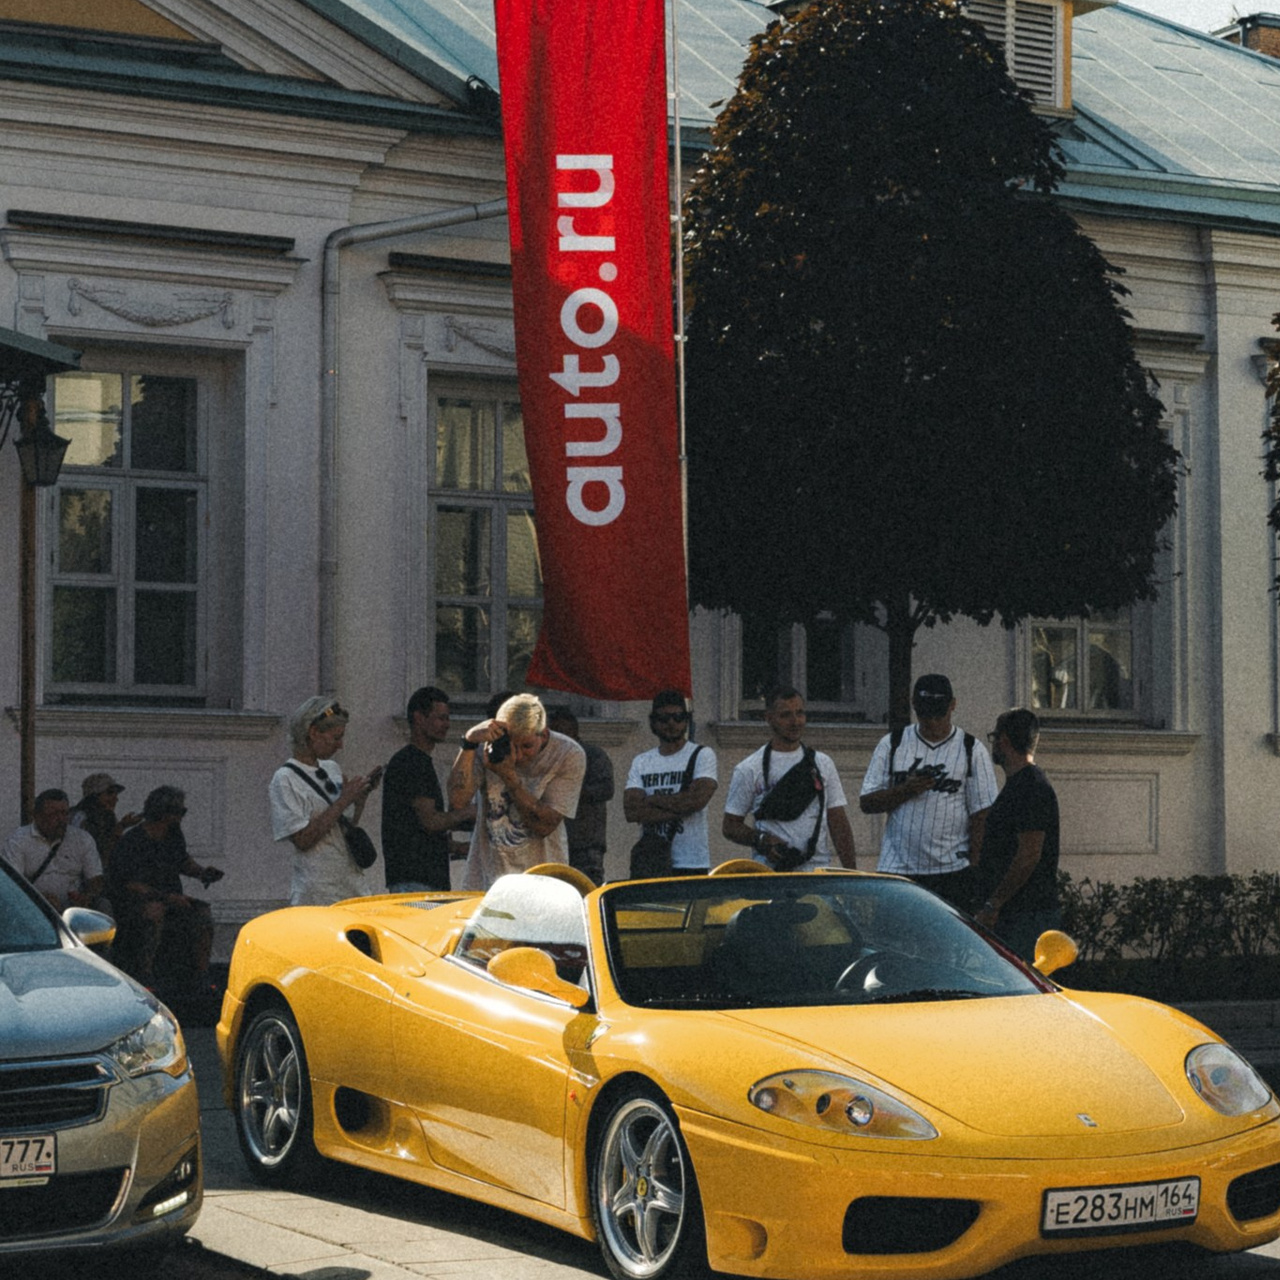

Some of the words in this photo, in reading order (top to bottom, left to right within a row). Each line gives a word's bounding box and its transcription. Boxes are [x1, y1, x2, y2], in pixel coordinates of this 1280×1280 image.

[550, 154, 625, 526] auto.ru
[1, 1138, 46, 1163] 777
[12, 1162, 34, 1172] RUS
[1159, 1183, 1192, 1208] 164
[1166, 1207, 1183, 1216] RUS
